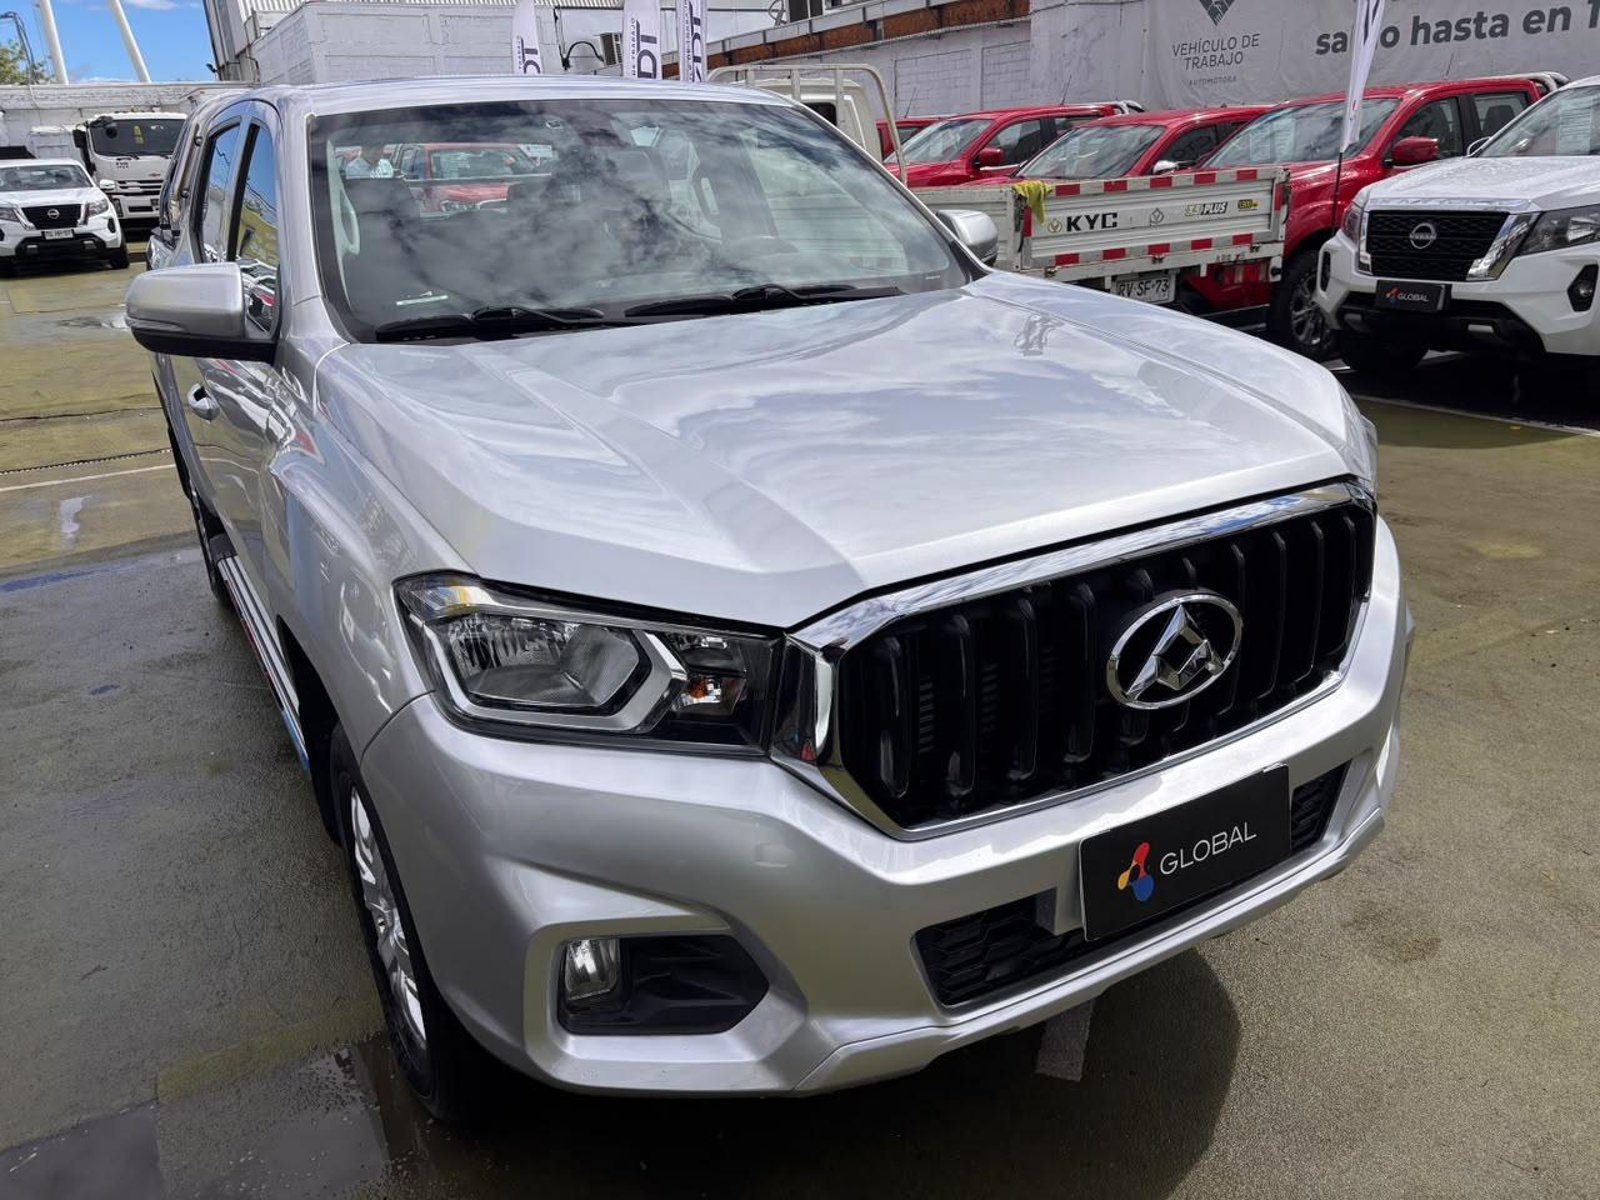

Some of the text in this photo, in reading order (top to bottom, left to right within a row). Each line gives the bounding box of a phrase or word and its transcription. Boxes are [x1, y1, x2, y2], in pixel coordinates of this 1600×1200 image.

[1315, 26, 1400, 55] sao
[1410, 11, 1509, 46] hasta
[1522, 5, 1572, 35] en
[1172, 33, 1260, 57] VEHÍCULO DE
[1184, 51, 1244, 71] TRABAJO
[1203, 202, 1226, 215] PLUS
[1066, 212, 1118, 232] KYC
[1159, 822, 1257, 875] GLOBAL
